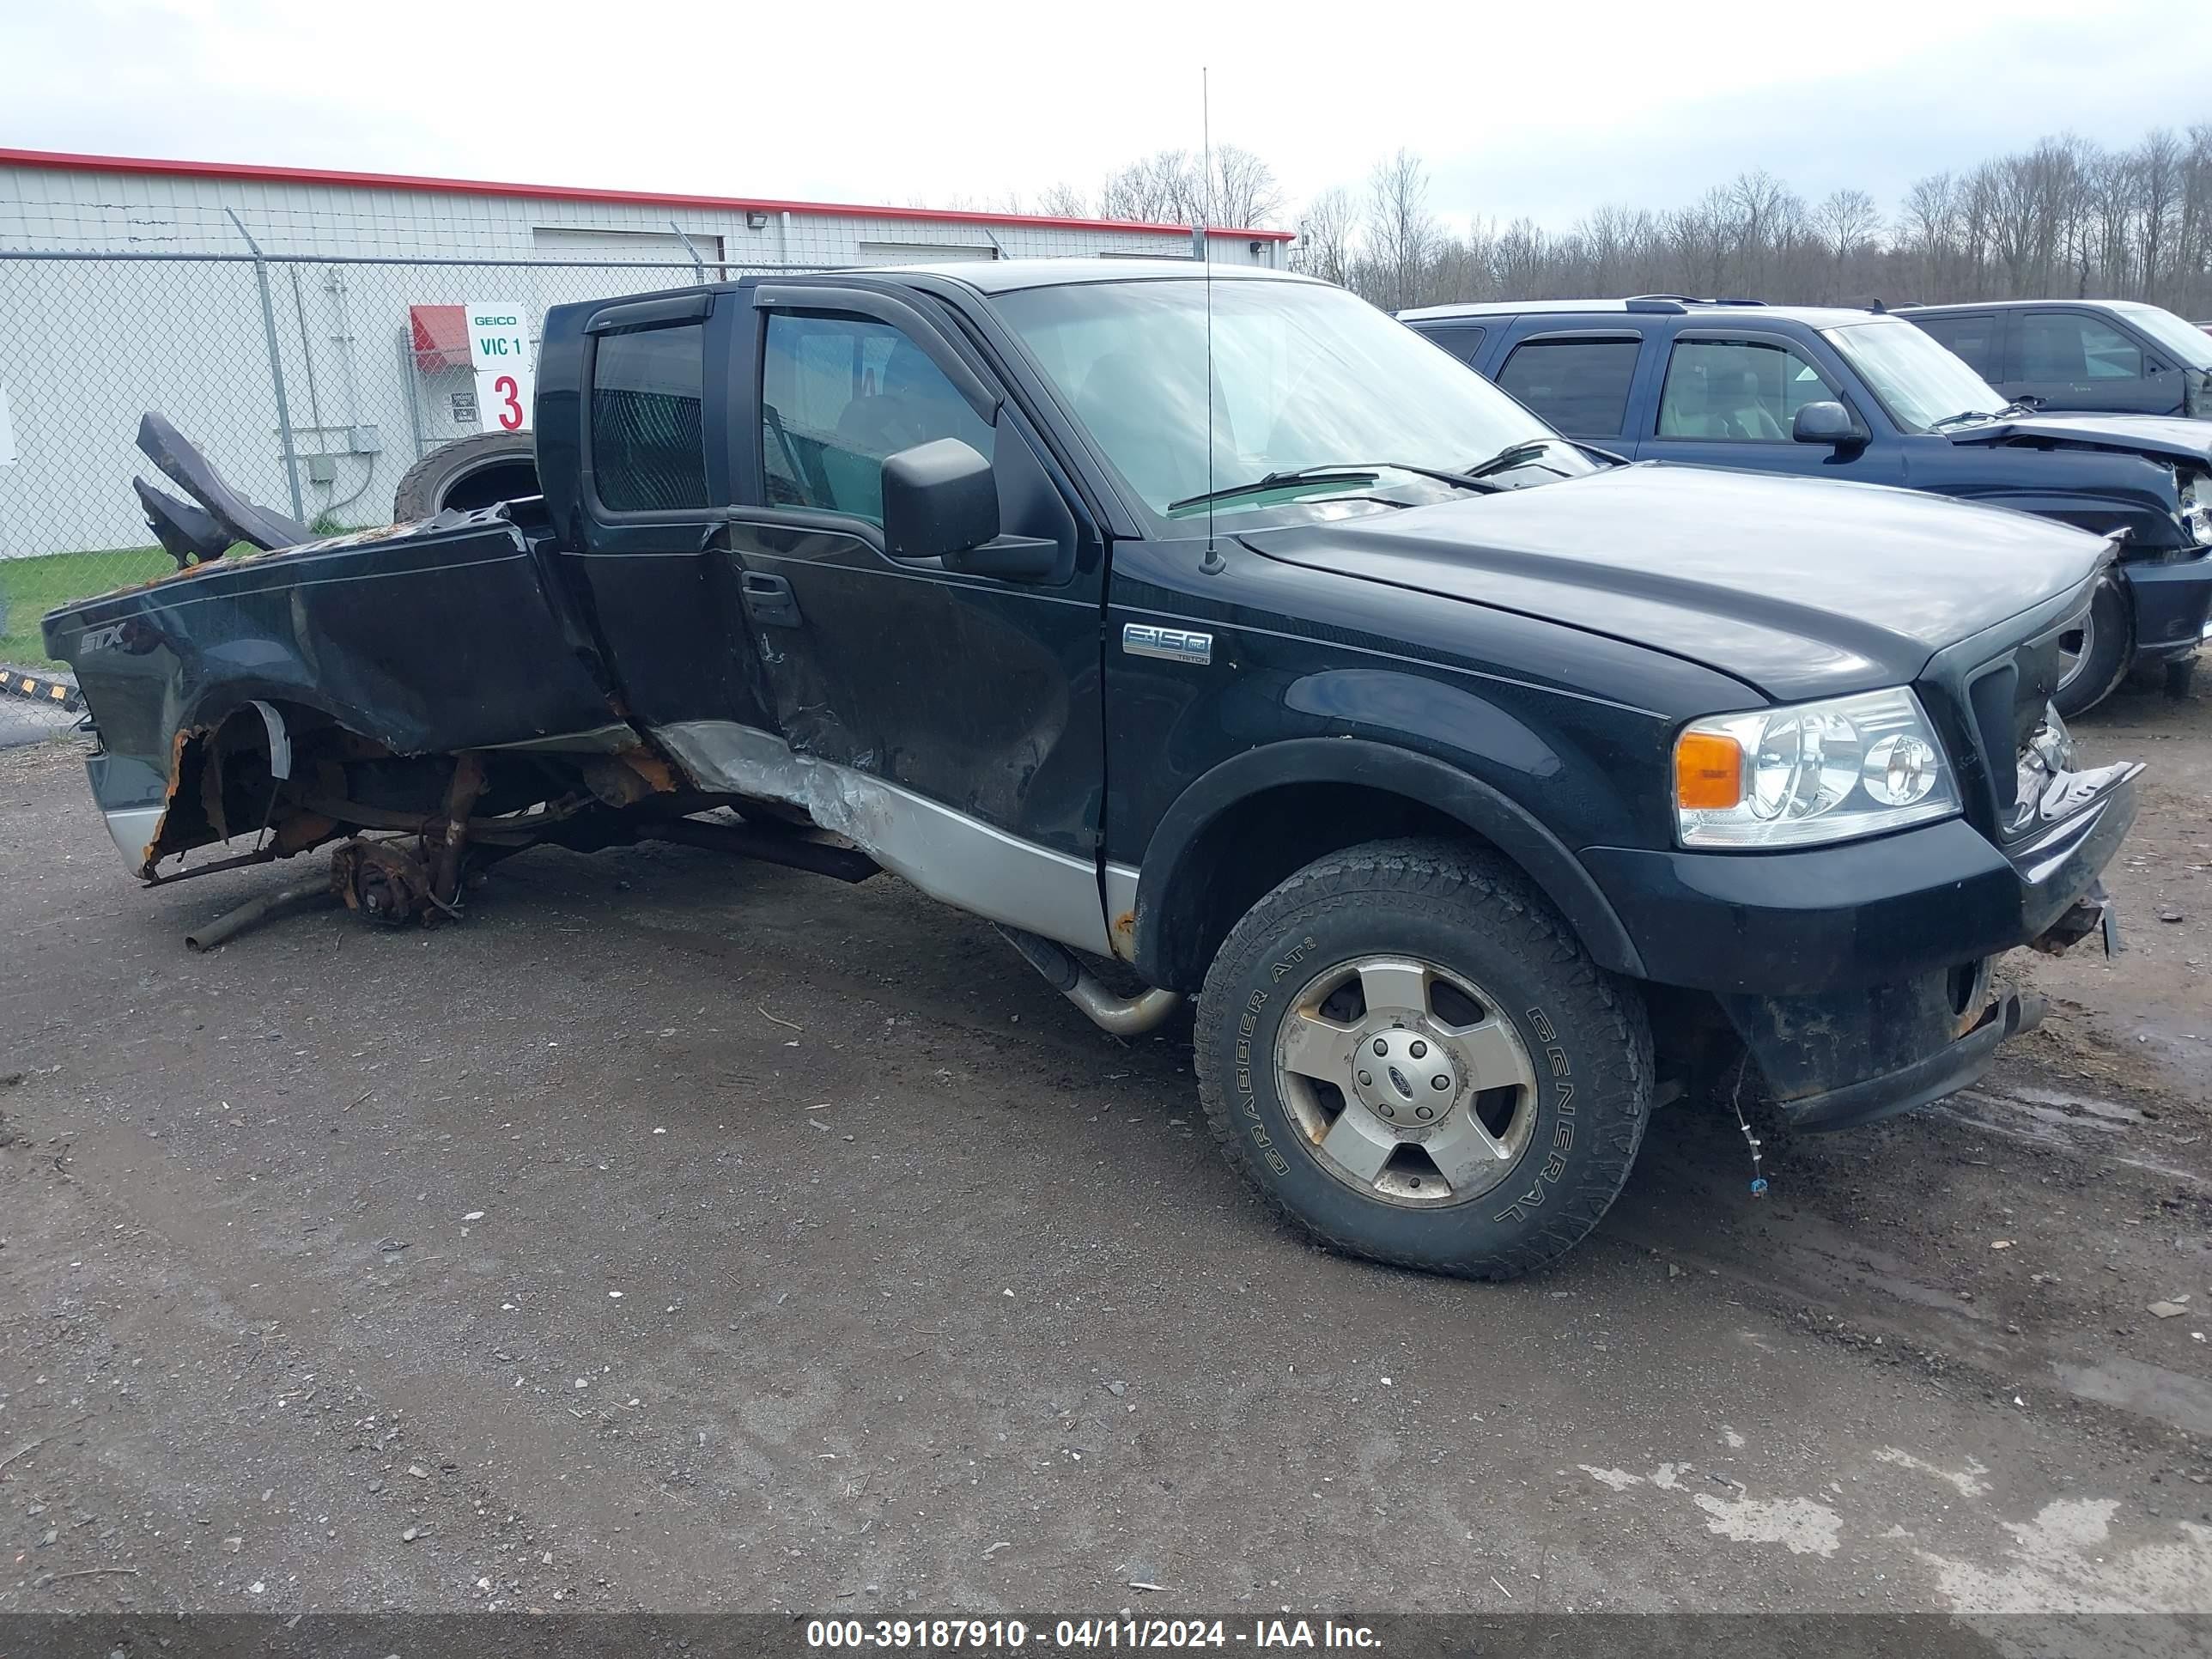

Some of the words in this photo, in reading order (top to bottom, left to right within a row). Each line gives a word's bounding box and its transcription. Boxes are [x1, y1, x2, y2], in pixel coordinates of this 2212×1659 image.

[475, 316, 517, 325] GEICO
[480, 337, 508, 356] VIC
[513, 337, 521, 355] 1
[495, 375, 524, 430] 3
[80, 623, 127, 654] STX
[1177, 653, 1210, 665] TRITON
[1235, 988, 1291, 1176] GRABBER
[1493, 1006, 1576, 1223] GENERAL
